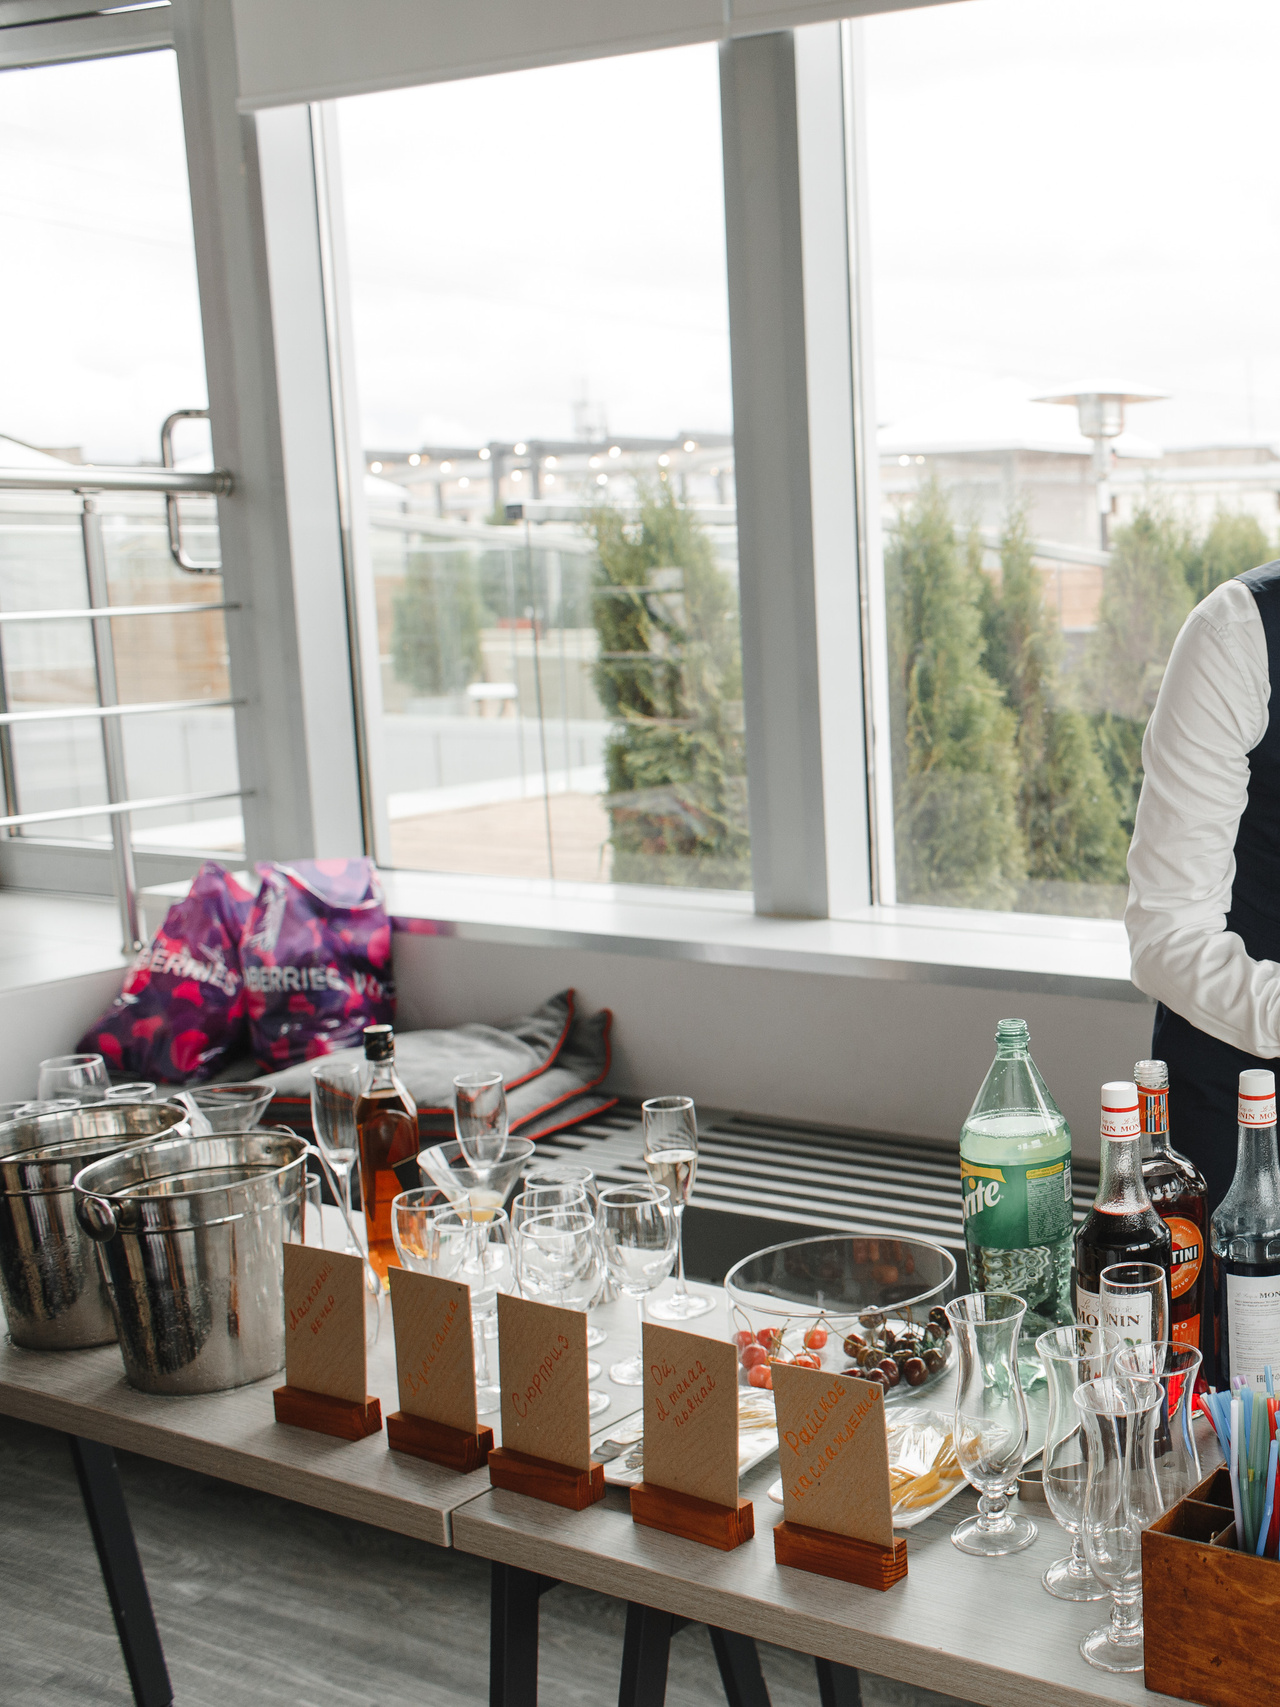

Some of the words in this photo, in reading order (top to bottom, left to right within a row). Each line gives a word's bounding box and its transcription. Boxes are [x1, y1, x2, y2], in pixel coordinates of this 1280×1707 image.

[1102, 1123, 1117, 1132] NIN
[1238, 1111, 1256, 1120] NIN
[964, 1176, 1001, 1220] rite
[1171, 1245, 1198, 1265] TINI
[404, 1299, 459, 1398] Хулиганка
[1173, 1322, 1188, 1331] RO
[512, 1334, 570, 1418] Сюрприз
[668, 1360, 707, 1405] такая
[672, 1374, 717, 1428] пьяная
